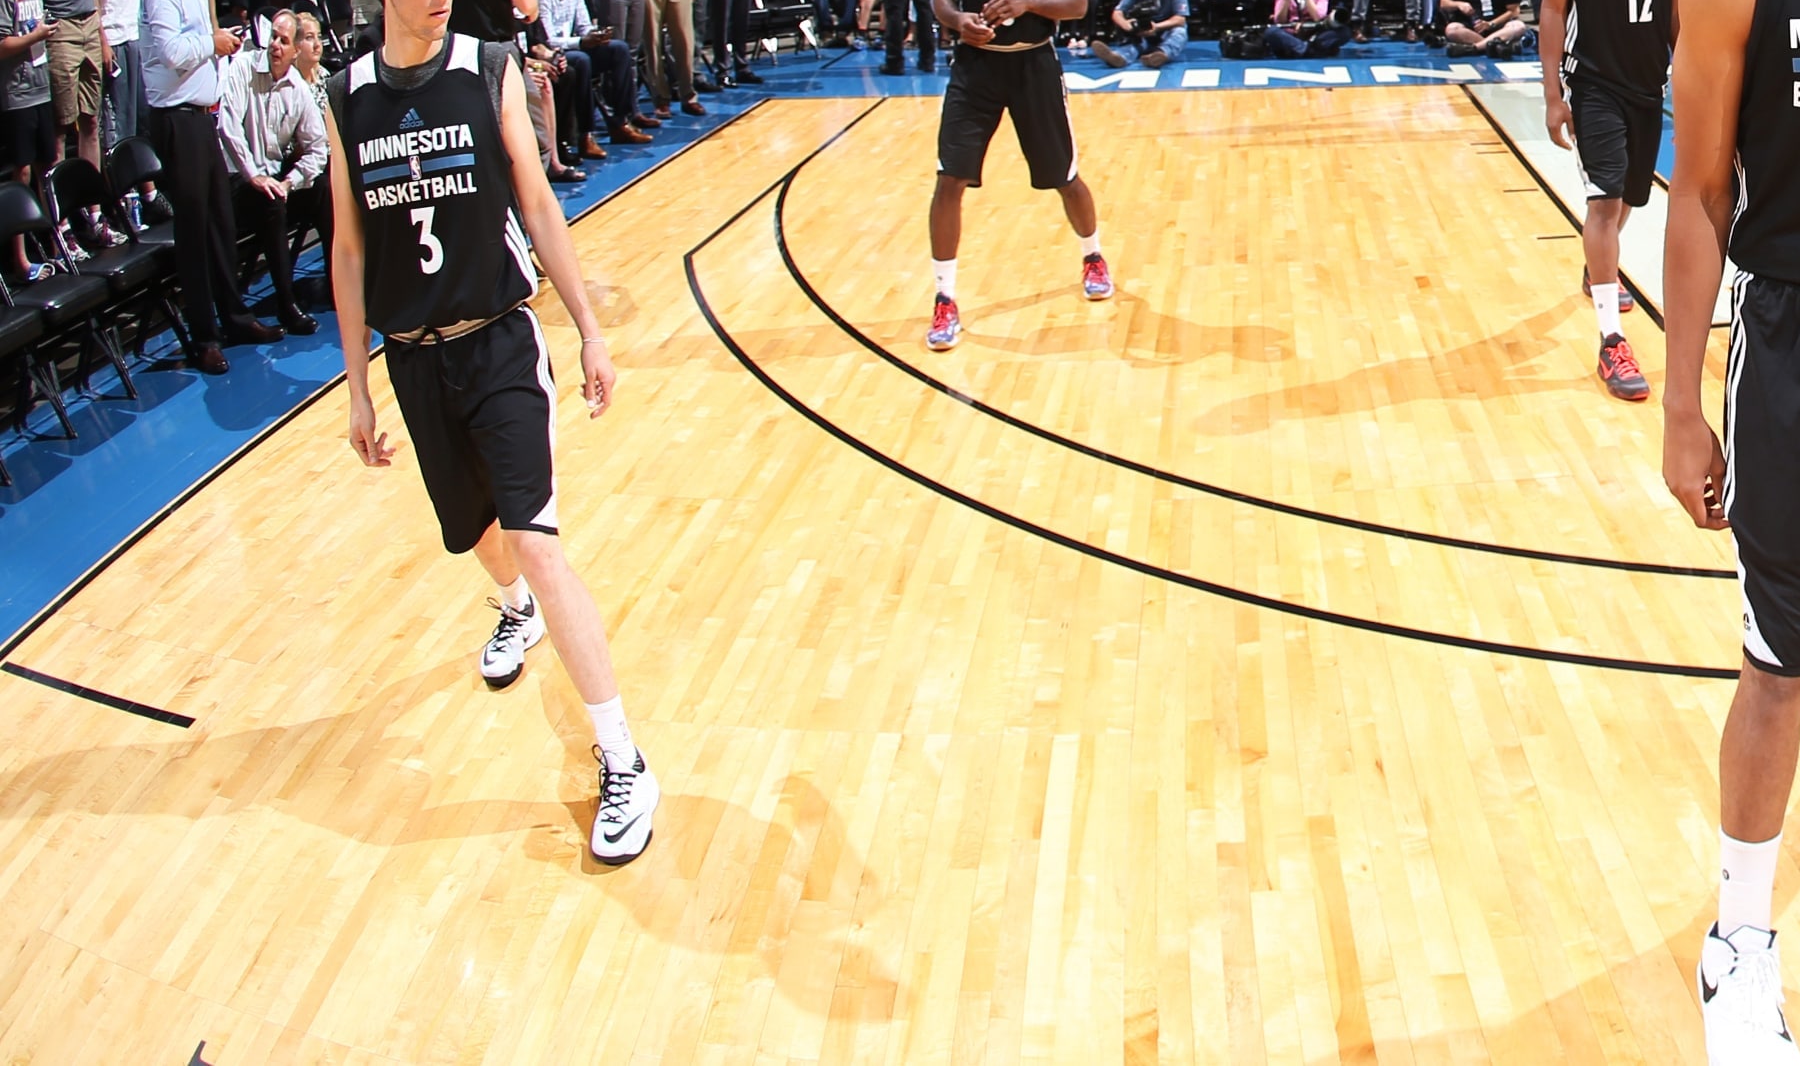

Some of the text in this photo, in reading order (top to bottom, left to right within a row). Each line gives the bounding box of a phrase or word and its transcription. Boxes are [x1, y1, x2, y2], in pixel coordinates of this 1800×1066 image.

[358, 123, 475, 167] MINNESOTA
[399, 119, 425, 130] adidas
[364, 172, 478, 211] BASKETBALL
[410, 205, 445, 275] 3
